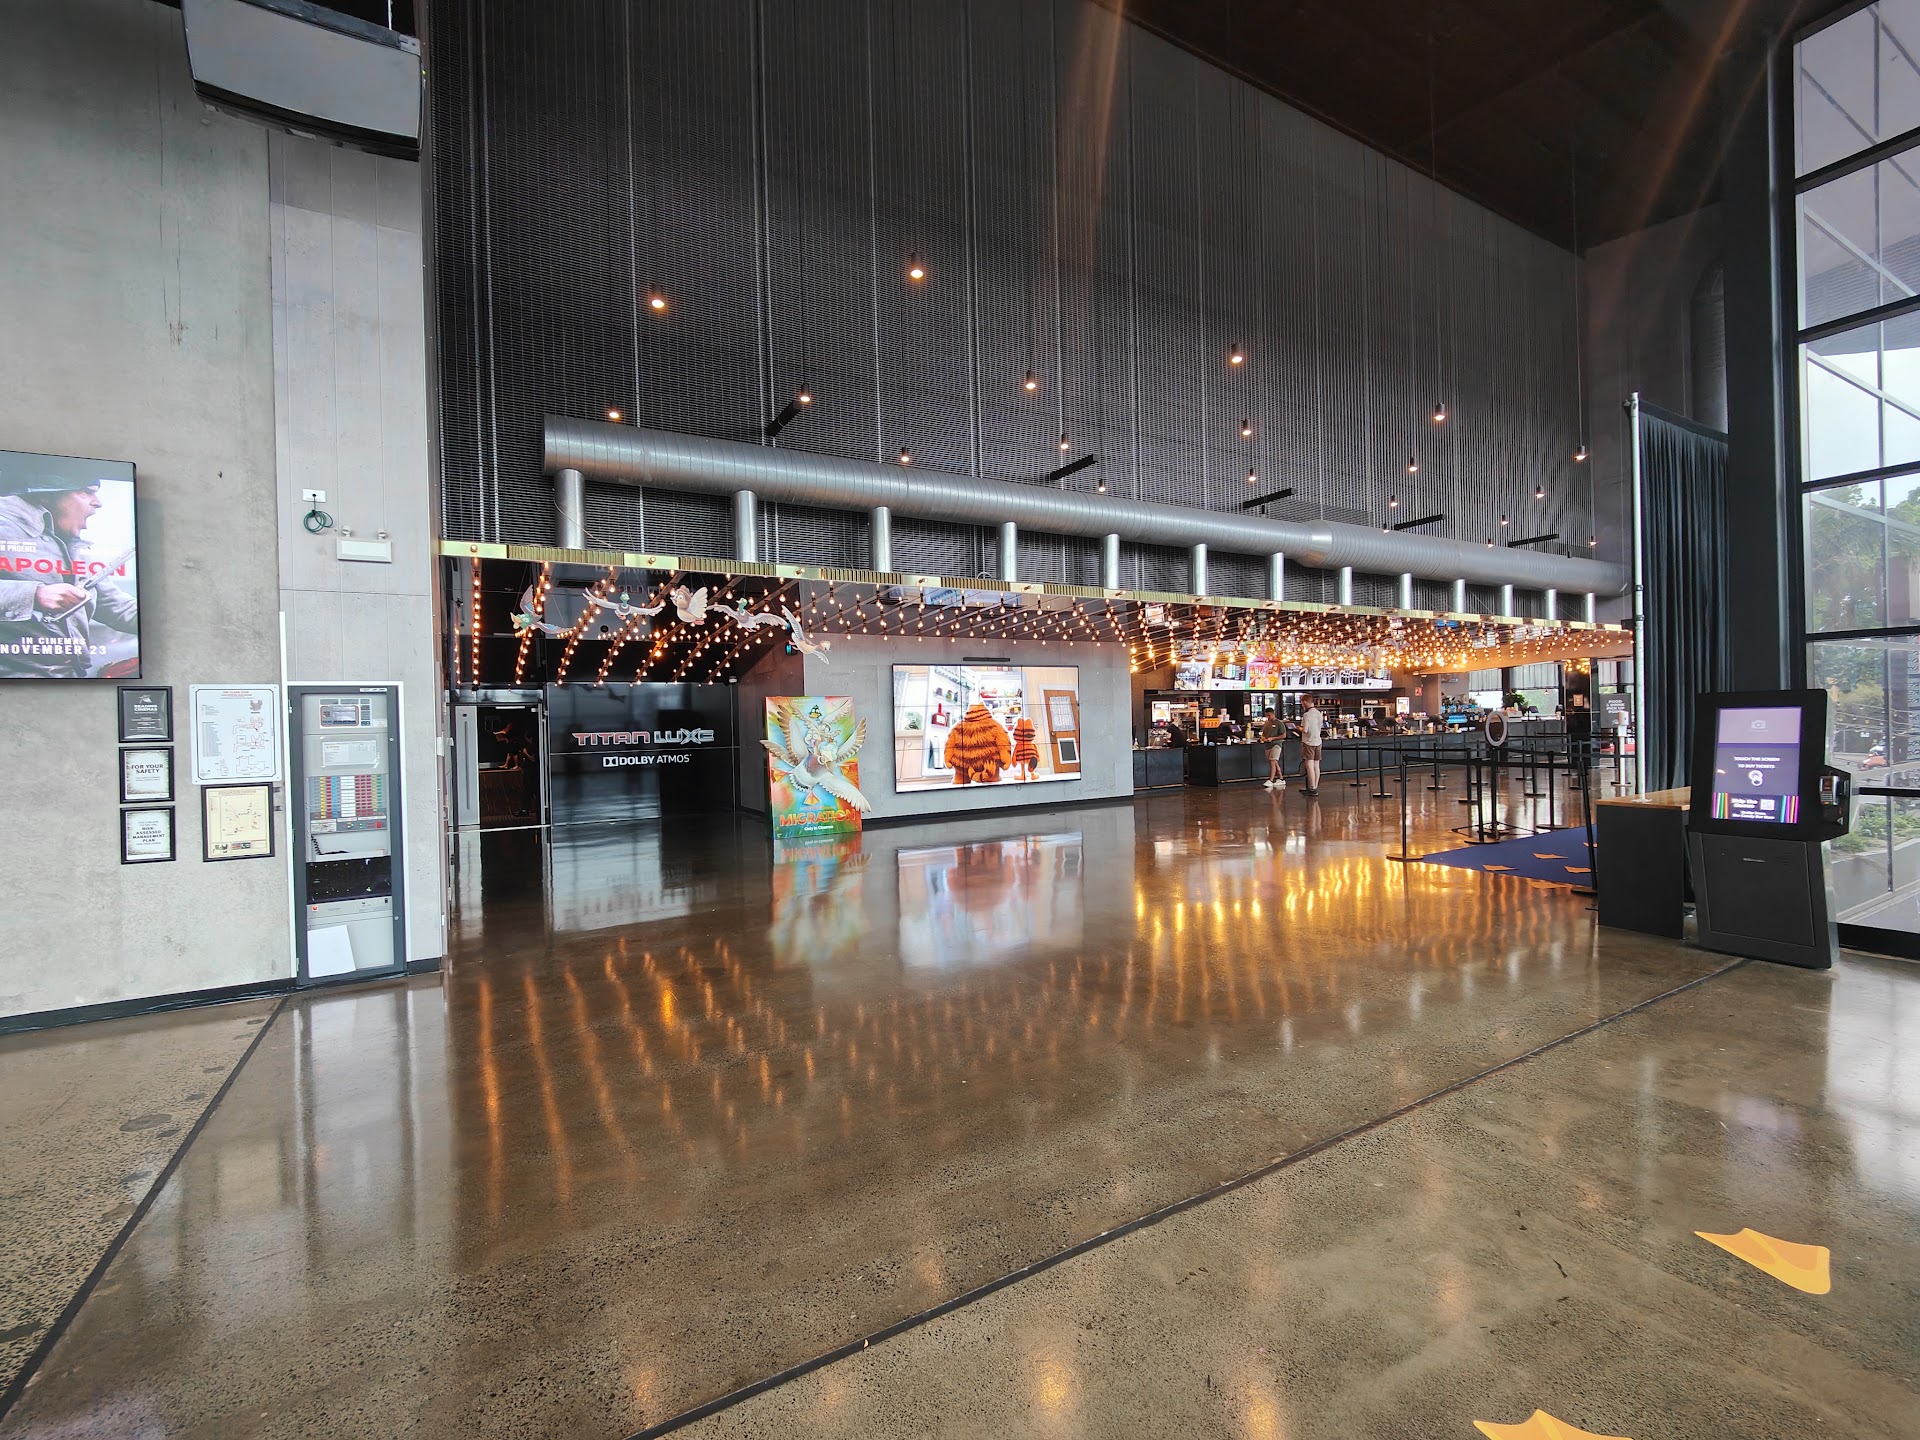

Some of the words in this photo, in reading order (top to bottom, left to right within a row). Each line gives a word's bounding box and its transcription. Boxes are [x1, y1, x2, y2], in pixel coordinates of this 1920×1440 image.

[7, 543, 37, 553] PHOENIX
[0, 556, 126, 577] APOLEON
[21, 636, 33, 645] IN
[38, 636, 87, 645] CINEMAS
[0, 644, 82, 655] NOVEMBER
[90, 645, 107, 655] 23
[572, 731, 651, 746] TITAN
[653, 728, 715, 745] LUXE
[619, 755, 655, 766] DOLBY
[656, 754, 690, 764] ATMOS
[779, 808, 856, 827] MIGRATION
